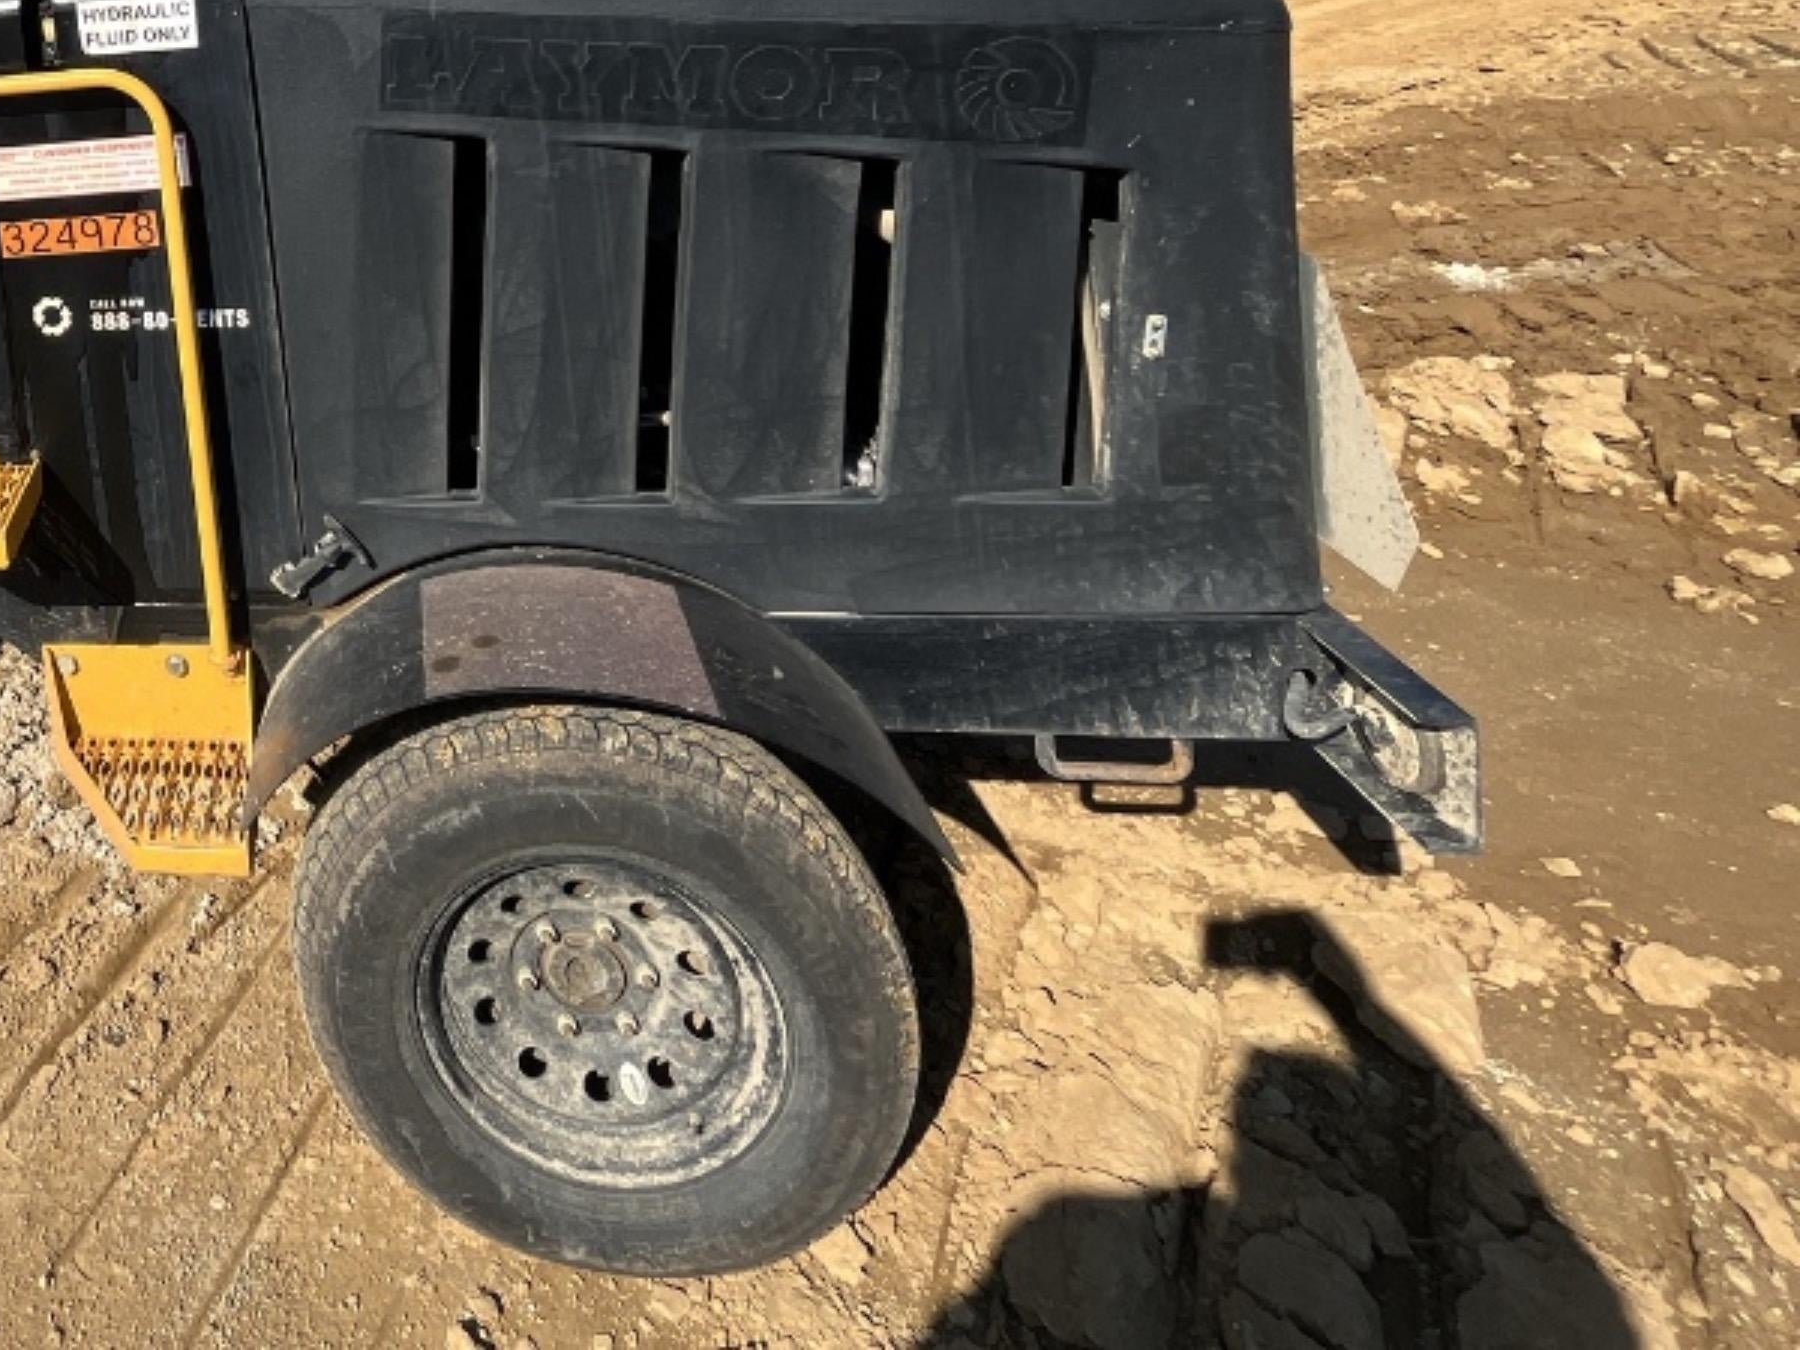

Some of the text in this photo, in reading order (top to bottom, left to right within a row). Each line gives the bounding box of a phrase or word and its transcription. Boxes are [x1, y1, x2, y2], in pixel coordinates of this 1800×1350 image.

[83, 0, 190, 24] HYDRAULIC
[86, 25, 190, 47] FLUID ONLY
[384, 34, 910, 122] LAYMOR
[2, 213, 156, 256] 324978
